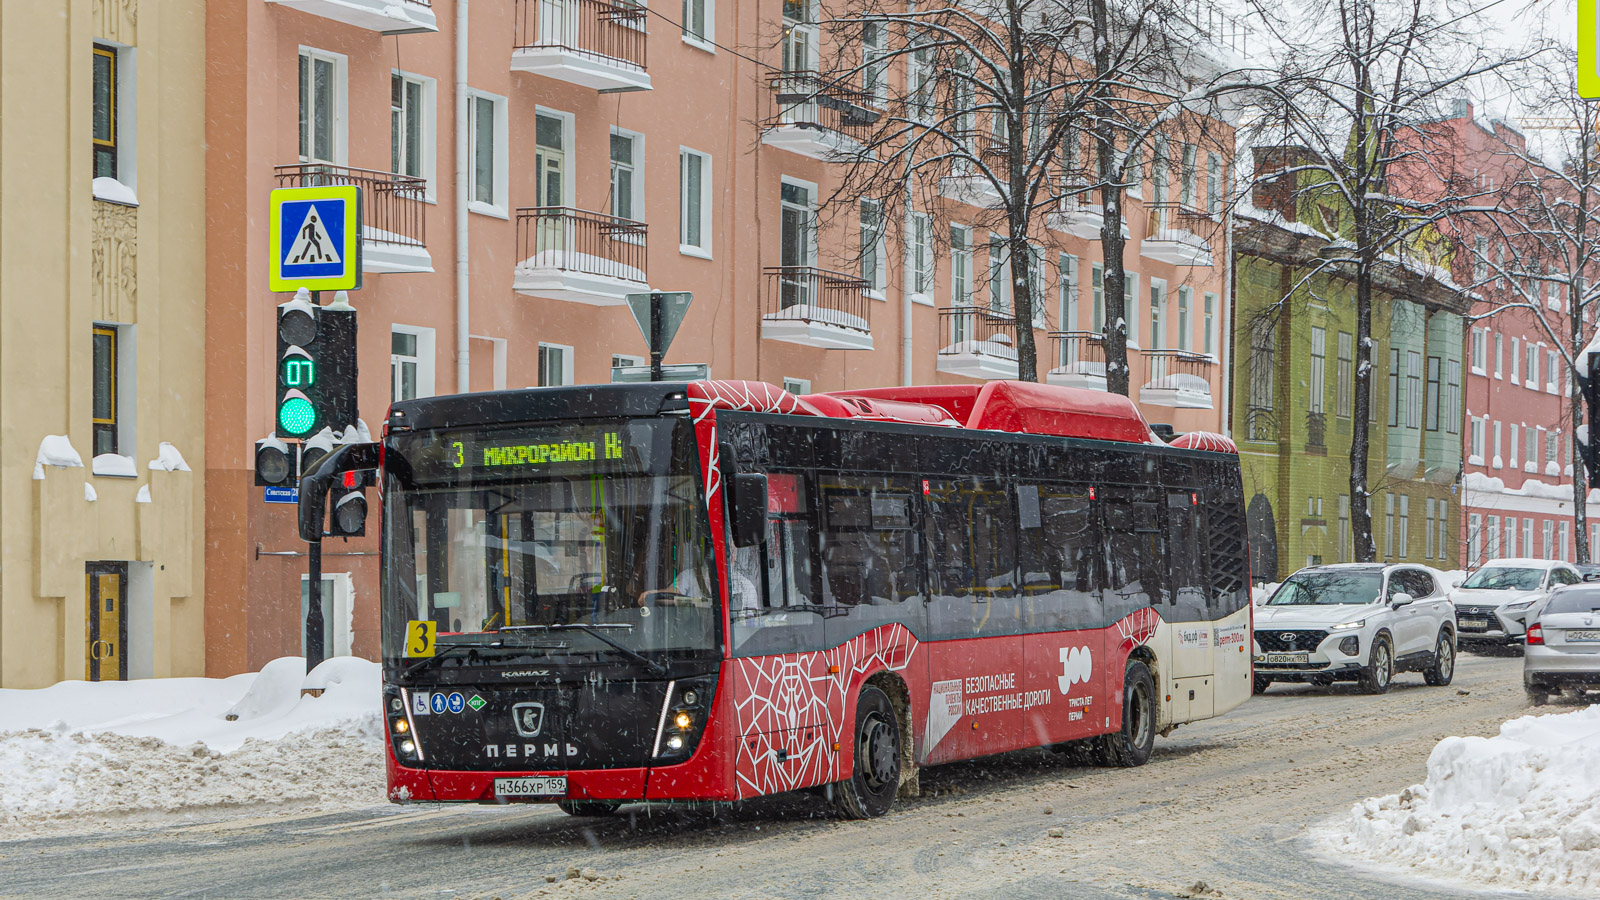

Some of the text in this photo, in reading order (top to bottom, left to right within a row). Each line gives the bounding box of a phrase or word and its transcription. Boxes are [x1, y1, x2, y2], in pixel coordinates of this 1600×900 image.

[287, 361, 313, 385] 07
[452, 441, 464, 468] 3
[413, 623, 429, 653] 3
[501, 670, 550, 678] KAMAZ
[1057, 645, 1092, 695] 300
[965, 672, 1015, 694] БЕЗОПАСНЫЕ
[965, 689, 1051, 715] КАЧЕСТВЕННЫЕ ДОРОГИ
[1068, 696, 1093, 707] ТРИСТА ЛЕТ
[1068, 711, 1083, 721] ПЕРМИ
[486, 743, 578, 758] ПЕРМЬ
[546, 779, 563, 789] 159
